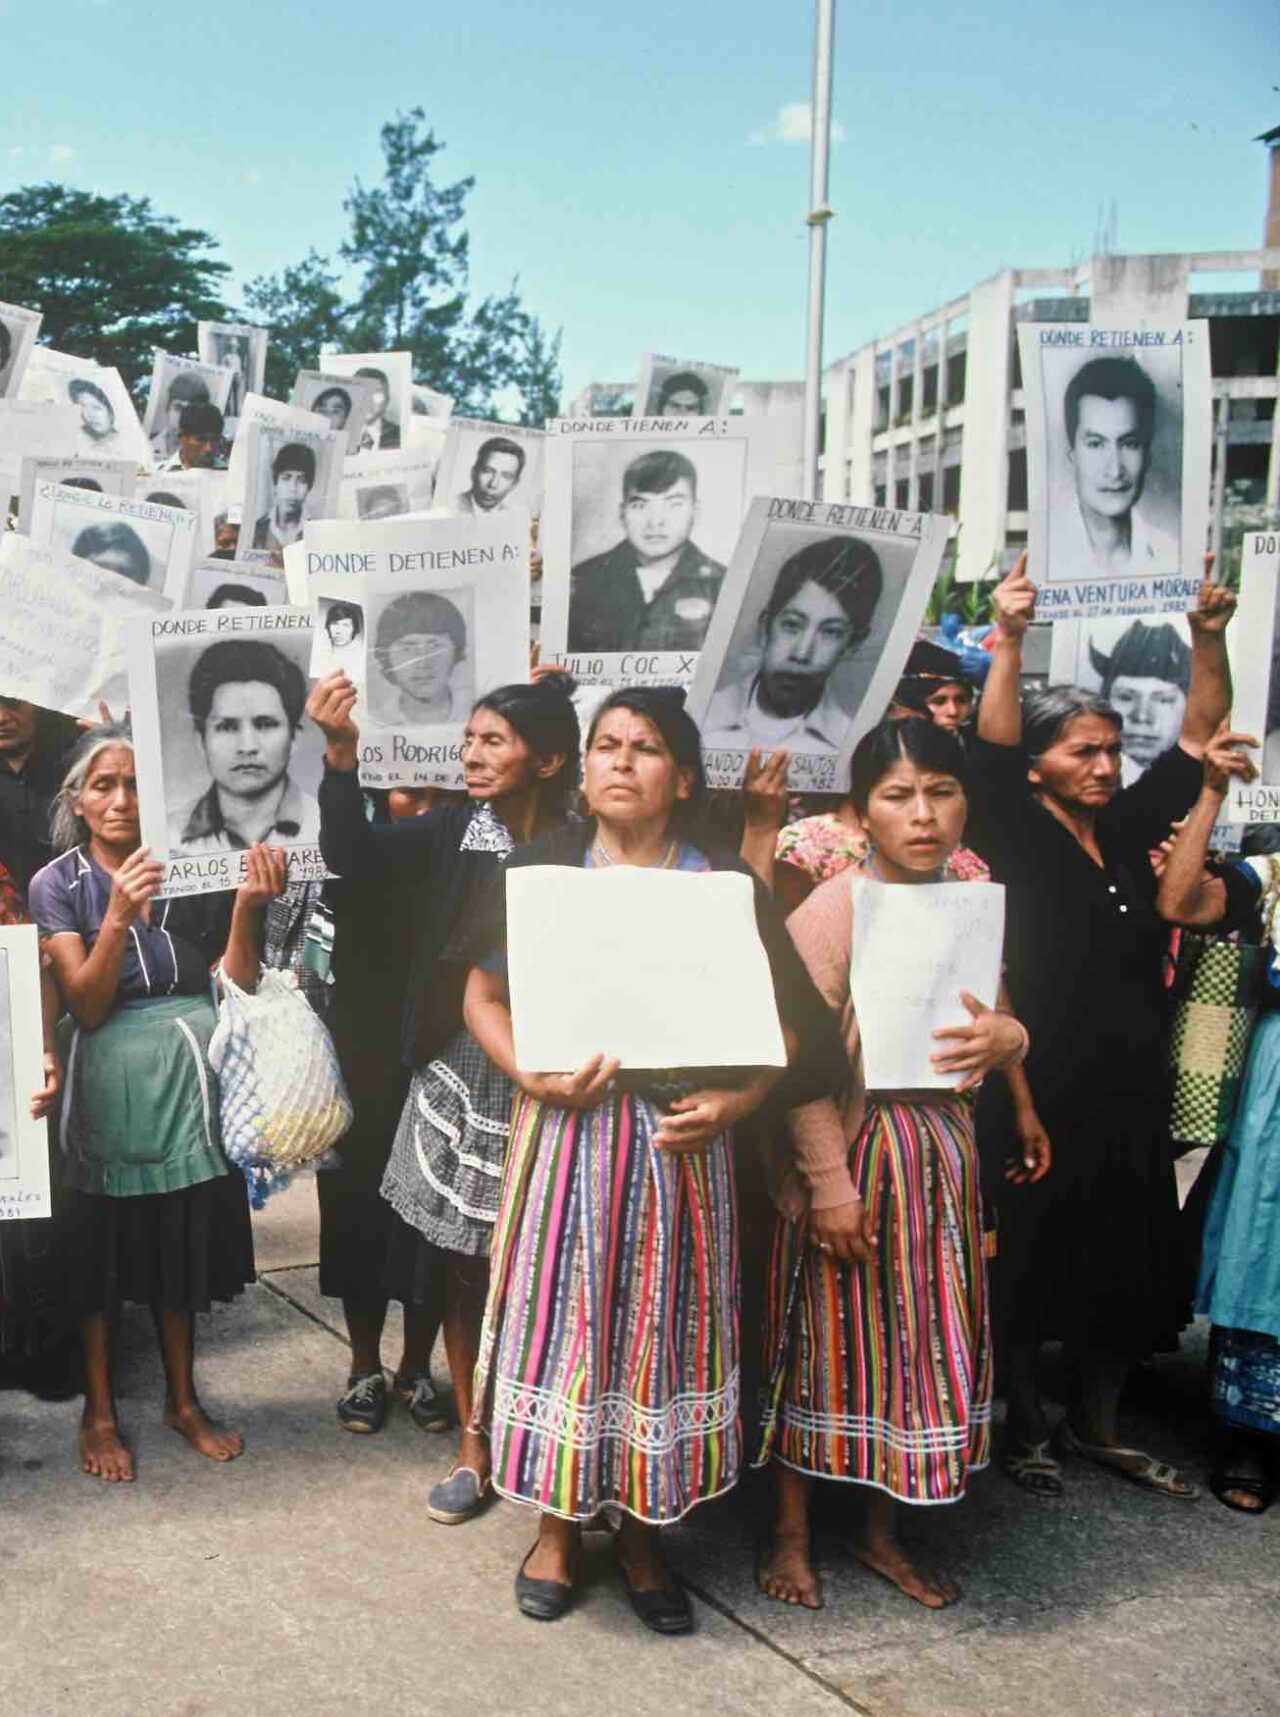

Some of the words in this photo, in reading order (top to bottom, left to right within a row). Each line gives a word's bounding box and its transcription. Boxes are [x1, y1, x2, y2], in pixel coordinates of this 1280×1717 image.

[307, 551, 377, 575] DONDE
[389, 546, 495, 573] DETIENEN
[151, 618, 208, 637] DONDE
